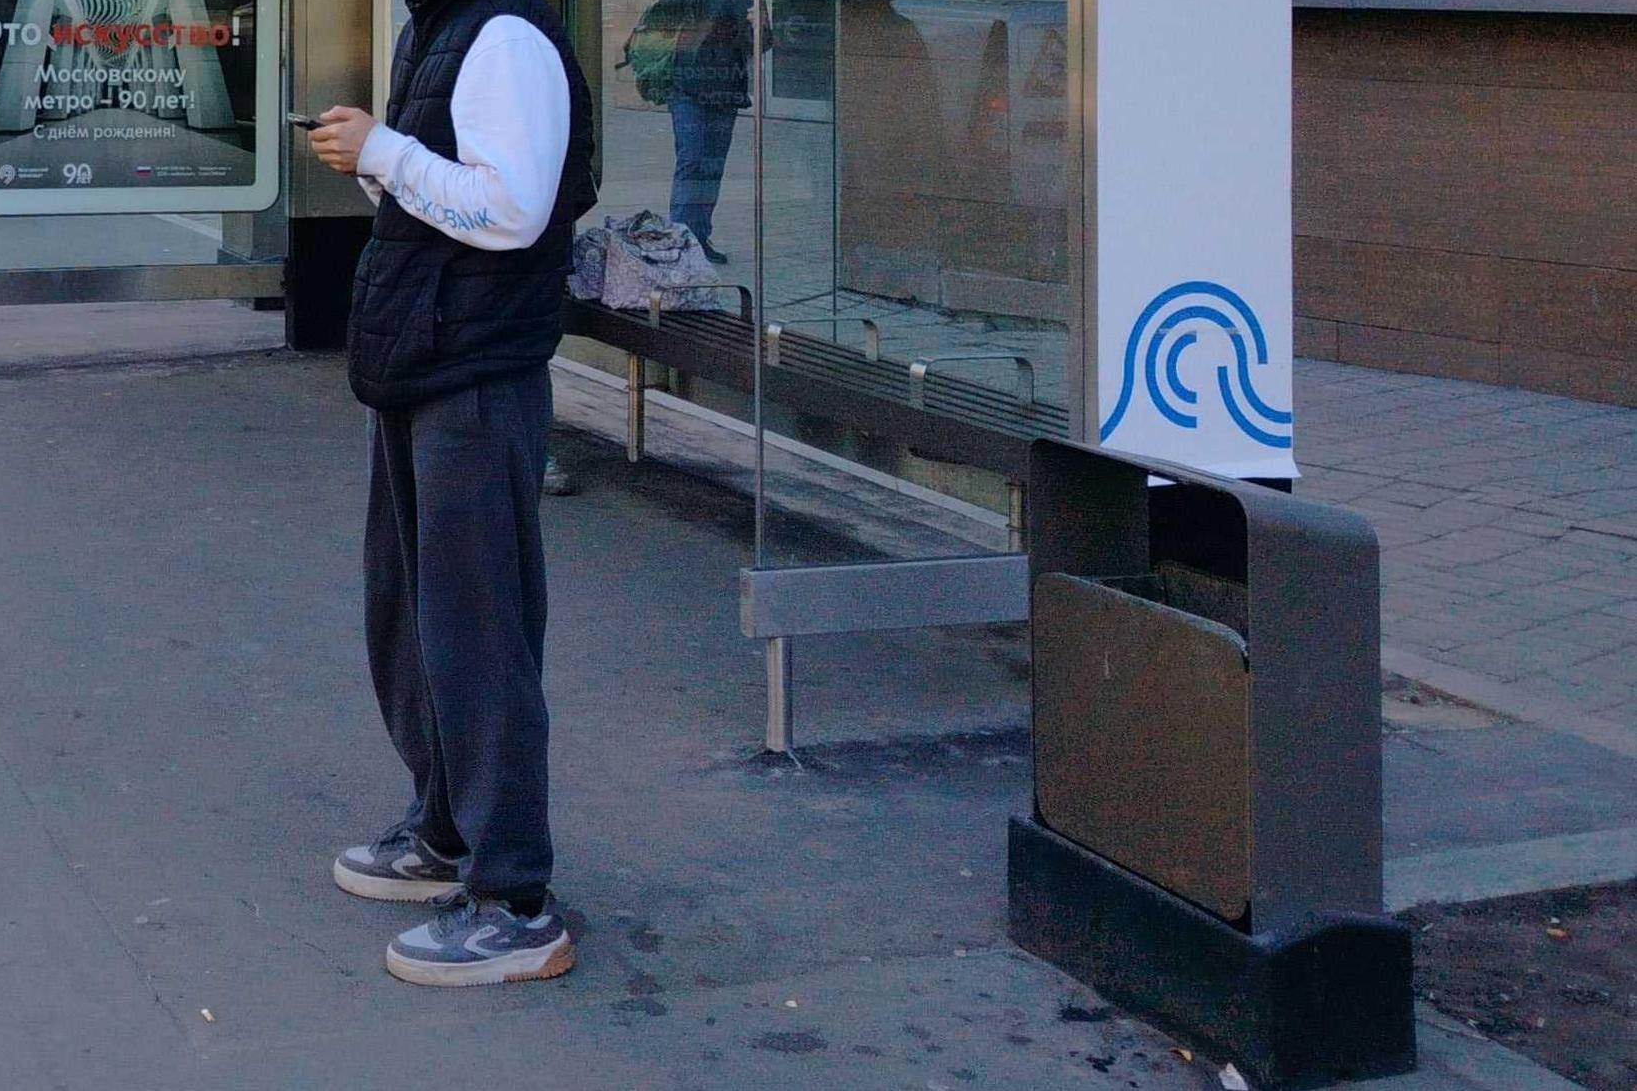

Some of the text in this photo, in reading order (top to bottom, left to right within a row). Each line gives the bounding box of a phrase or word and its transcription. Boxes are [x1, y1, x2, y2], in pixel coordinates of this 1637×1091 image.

[52, 16, 240, 53] искусство!
[34, 65, 186, 86] Московскому
[25, 94, 93, 111] метро
[118, 91, 147, 109] 90
[153, 91, 195, 110] лет!
[34, 124, 176, 141] С днём рождения!
